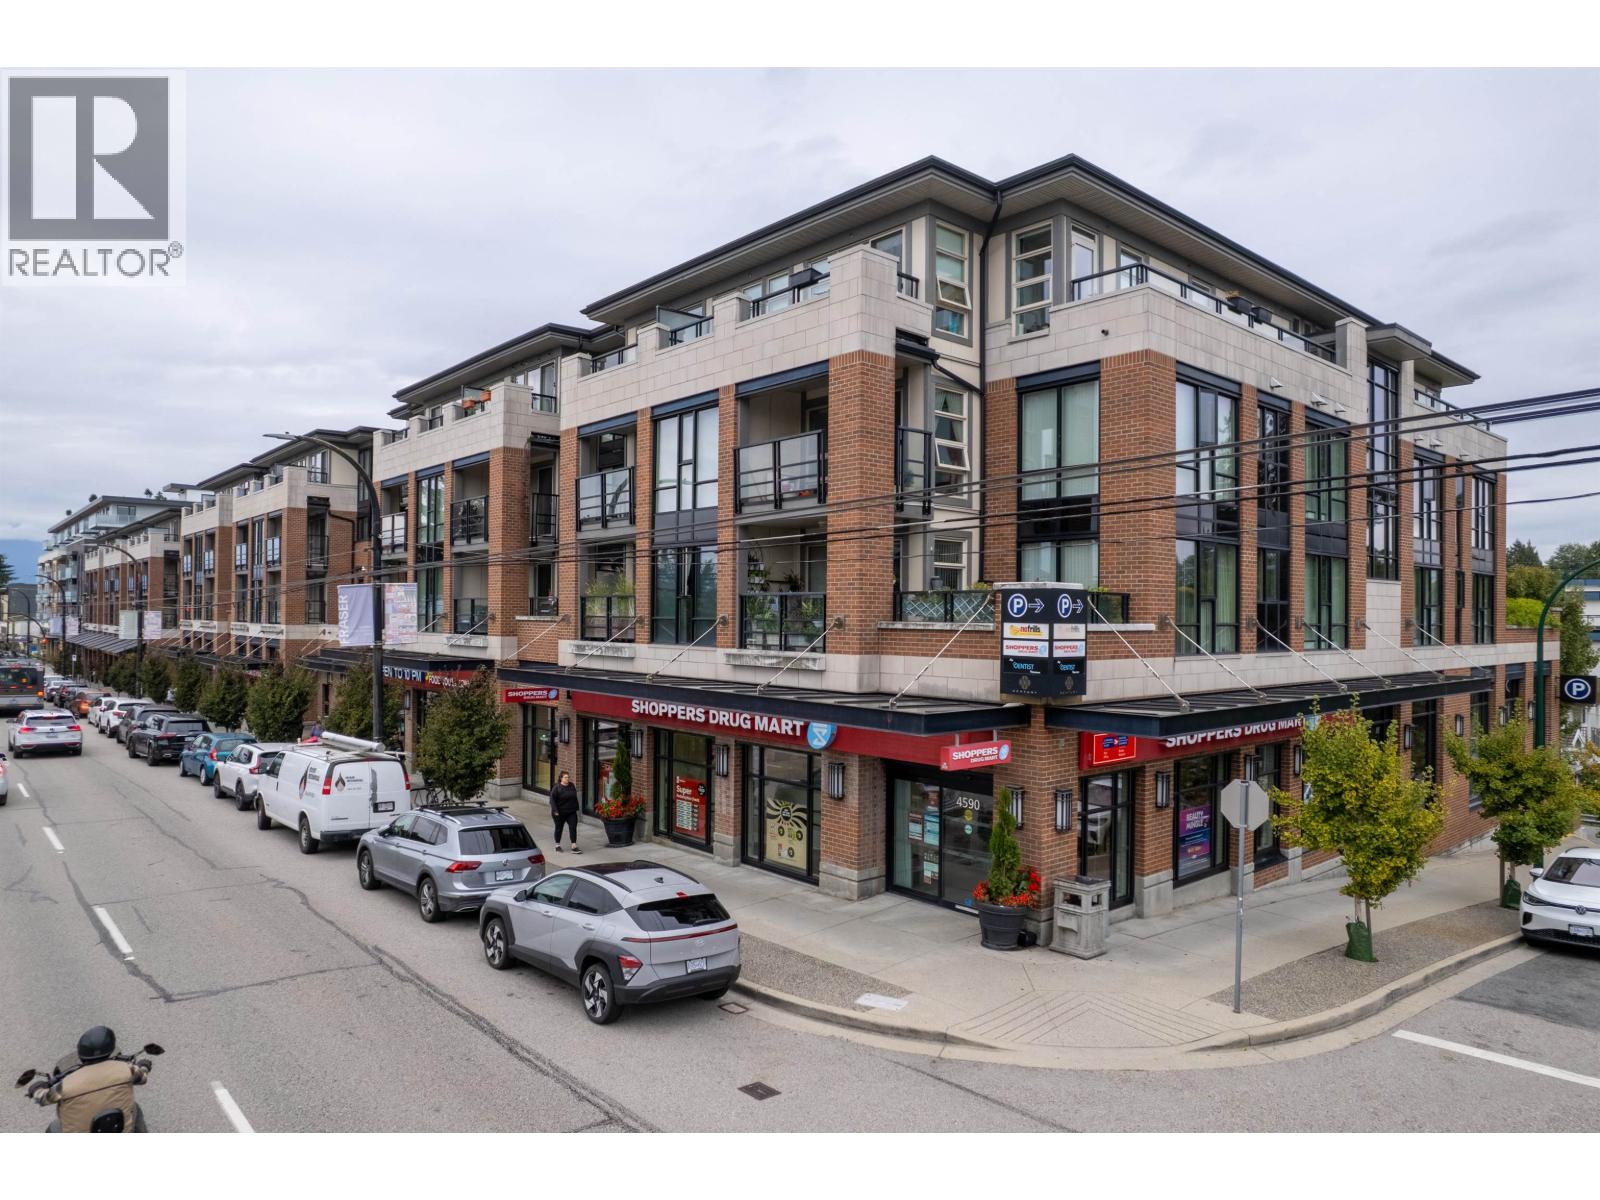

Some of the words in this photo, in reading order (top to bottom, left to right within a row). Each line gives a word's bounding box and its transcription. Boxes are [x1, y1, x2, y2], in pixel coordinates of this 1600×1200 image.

[1572, 682, 1586, 696] P
[631, 699, 705, 722] SHOPPERS
[709, 709, 751, 729] DRUG
[754, 715, 804, 736] MART
[1166, 727, 1242, 748] SHOPPERS
[1244, 721, 1276, 736] DRUG
[952, 746, 998, 760] SHOPPERS
[956, 797, 980, 810] 4590
